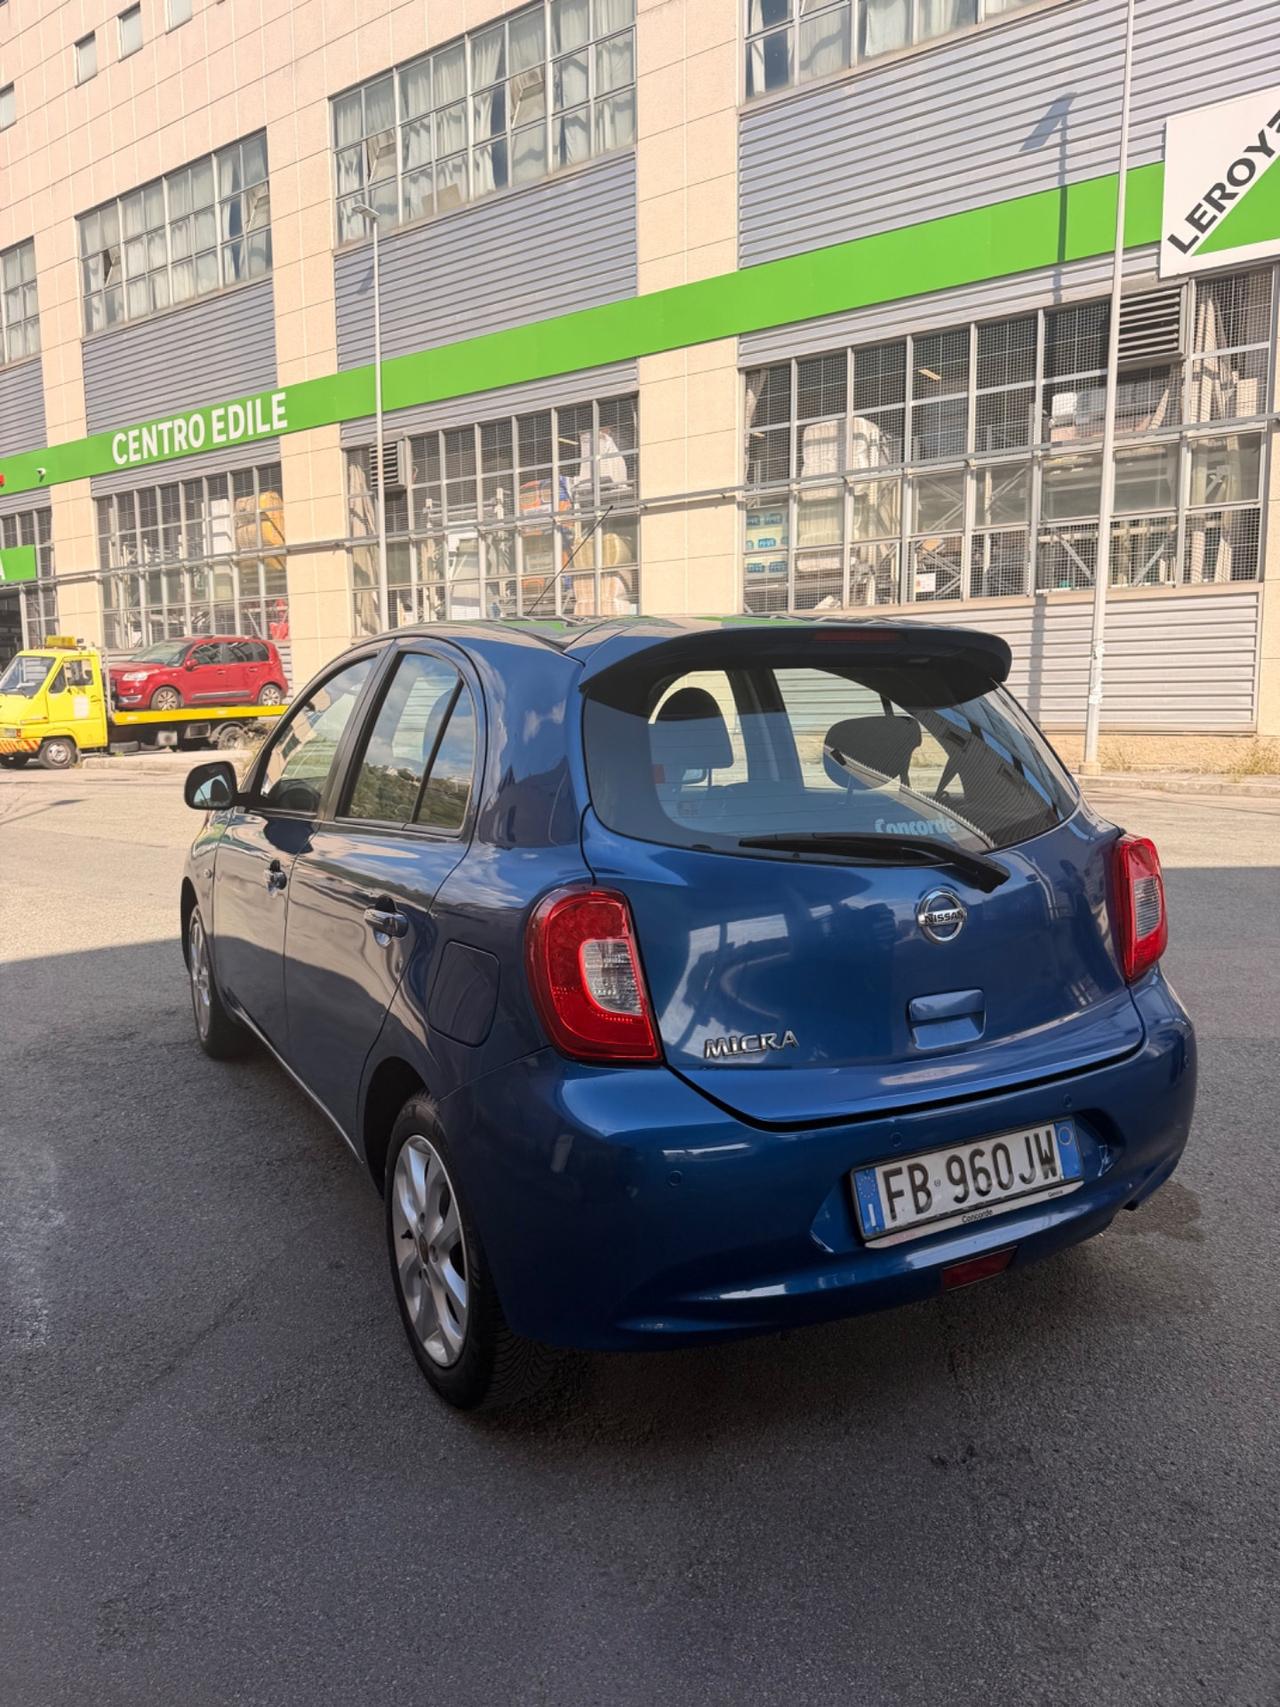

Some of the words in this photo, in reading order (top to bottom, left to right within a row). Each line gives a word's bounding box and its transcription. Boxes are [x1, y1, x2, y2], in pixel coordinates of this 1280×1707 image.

[1167, 129, 1276, 255] LEROY
[111, 413, 205, 465] CENTRO
[211, 392, 288, 444] EDILE
[924, 909, 964, 924] NISSAN
[704, 1029, 799, 1058] MICRA
[882, 1162, 932, 1222] FB
